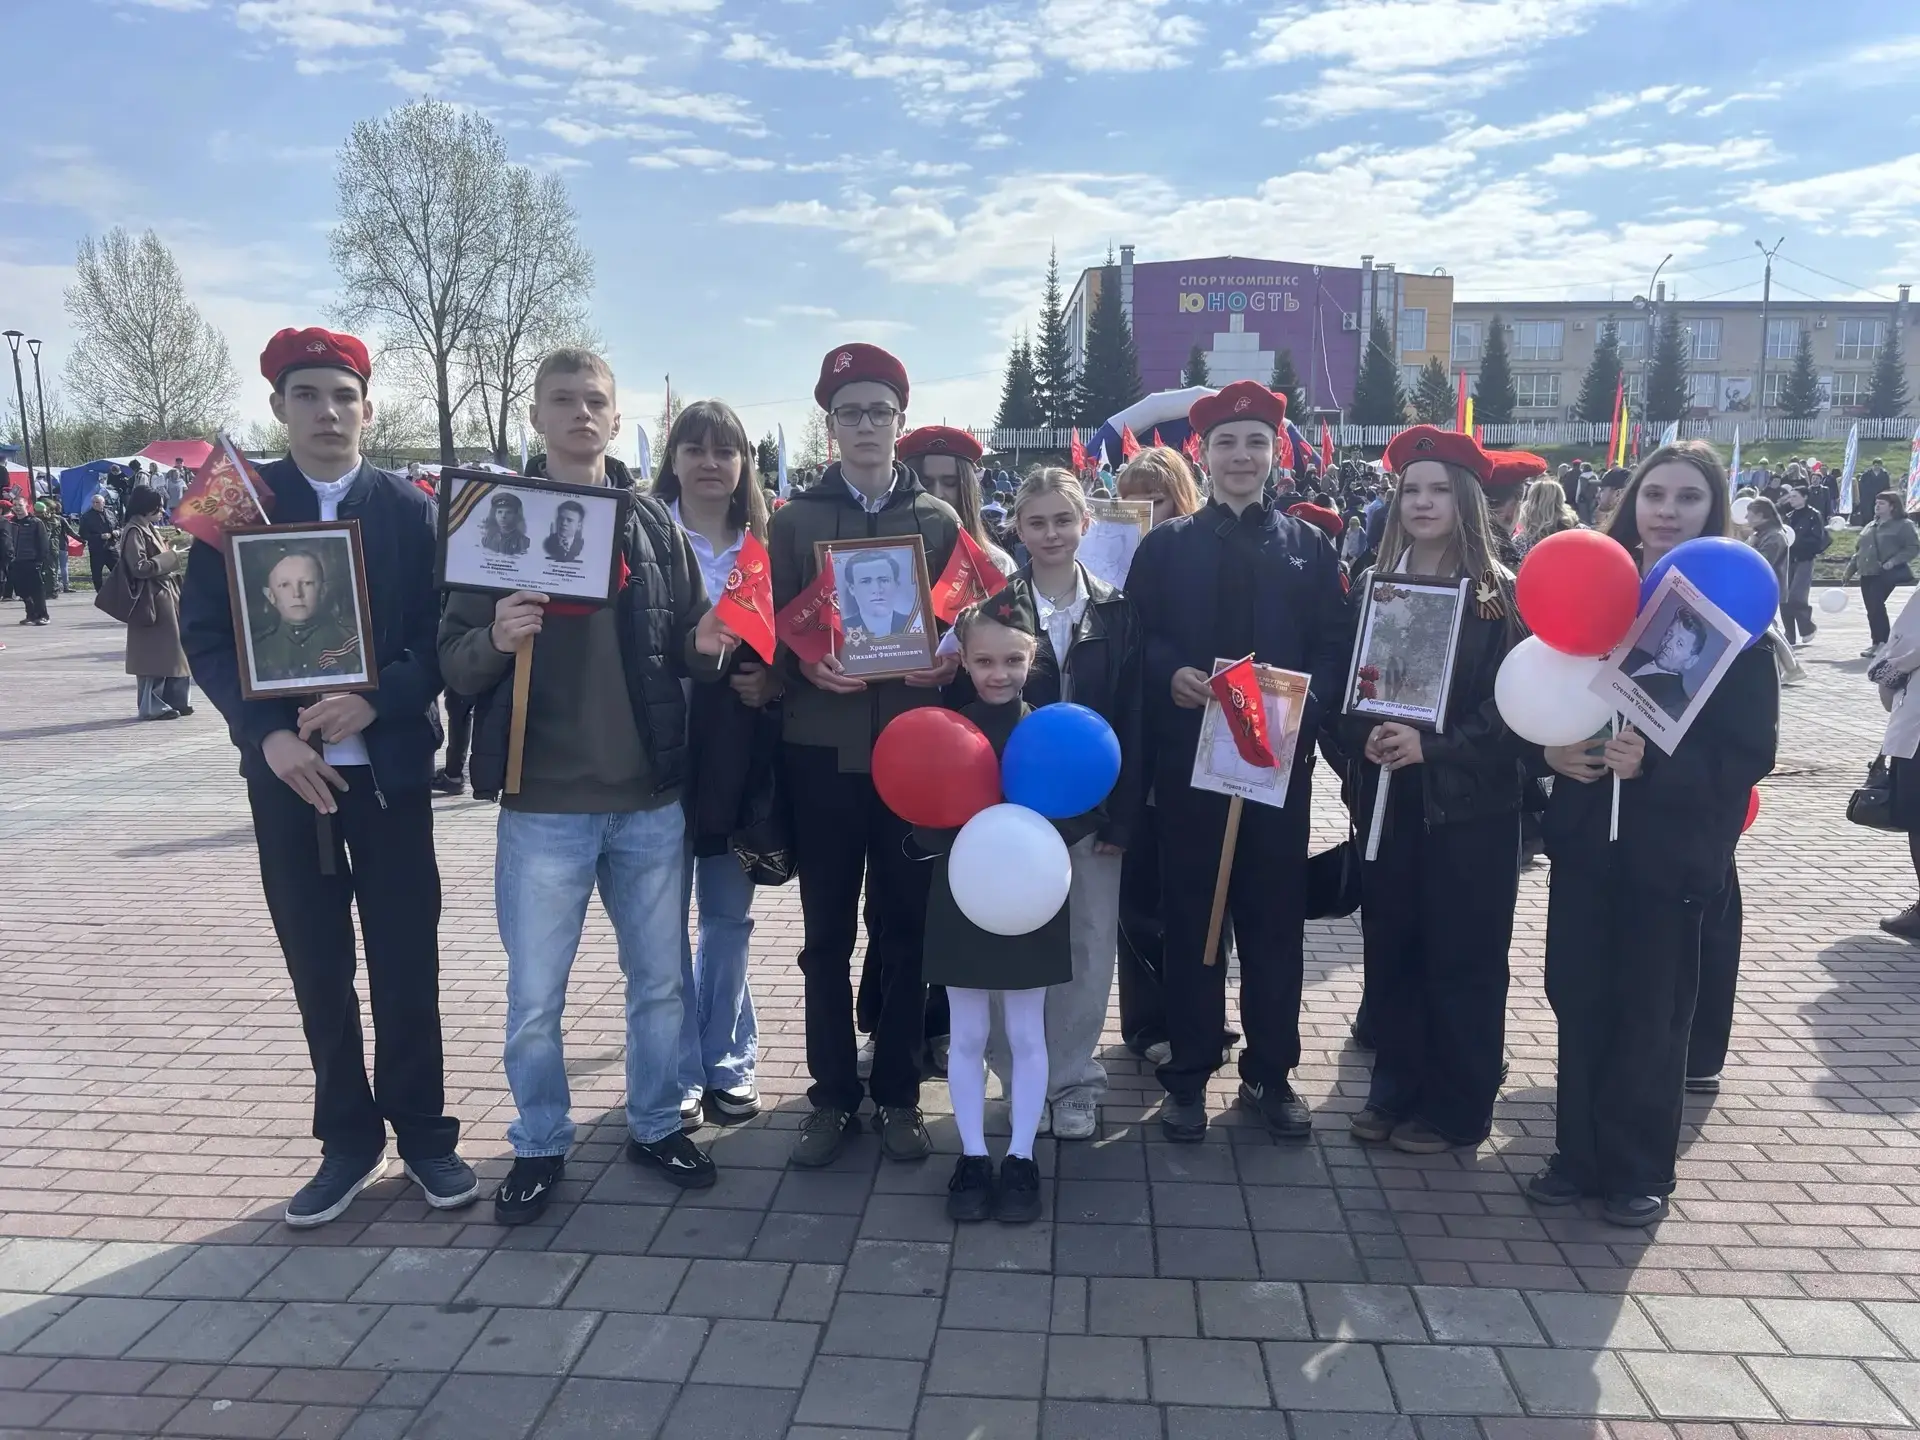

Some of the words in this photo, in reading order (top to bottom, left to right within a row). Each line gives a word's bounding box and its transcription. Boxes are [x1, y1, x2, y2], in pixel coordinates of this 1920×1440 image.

[1179, 275, 1299, 286] СПОРТКОМПЛЕКС
[1178, 290, 1300, 313] ЮНОСТЬ
[869, 644, 901, 652] Храмцов
[849, 653, 878, 661] Михаил
[878, 649, 923, 658] Филиппович
[1612, 681, 1635, 703] Степан
[1635, 699, 1666, 732] Устинович
